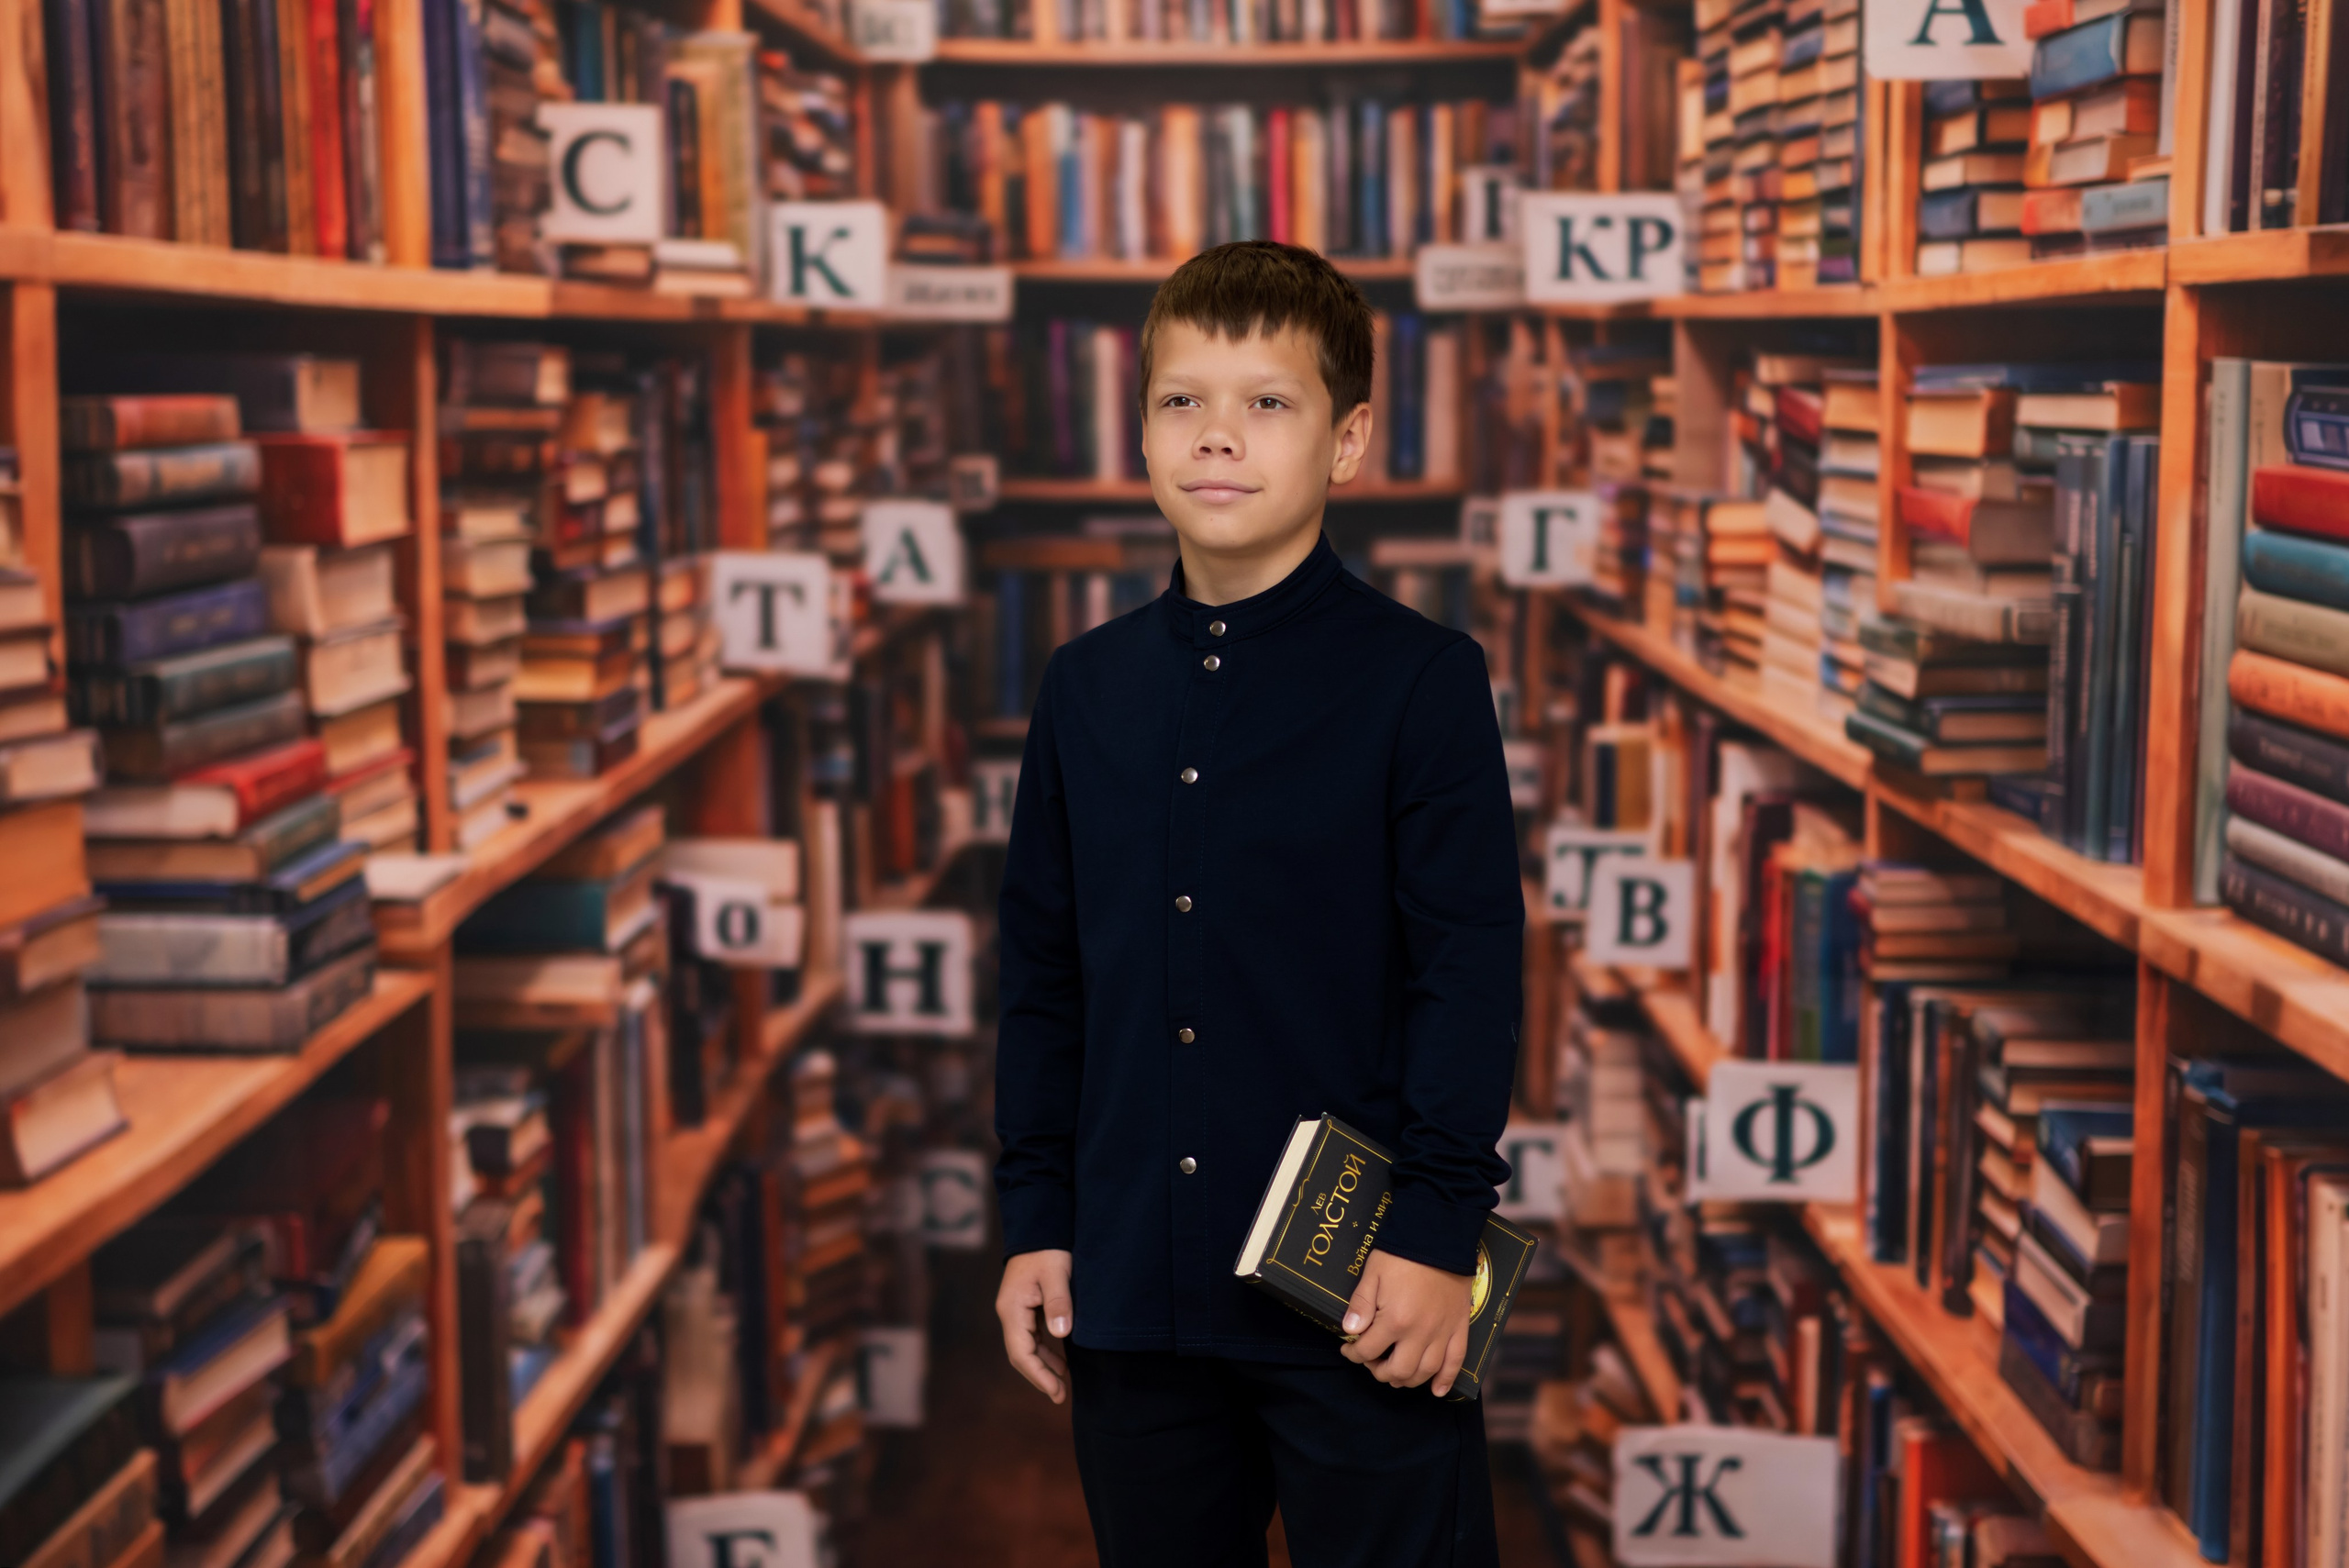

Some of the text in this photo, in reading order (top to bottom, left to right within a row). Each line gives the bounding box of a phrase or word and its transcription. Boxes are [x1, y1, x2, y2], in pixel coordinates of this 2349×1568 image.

[561, 128, 632, 217] С
[786, 225, 856, 298] К
[1553, 214, 1674, 282] КР
[878, 526, 934, 584] А
[1529, 506, 1578, 573] Г
[729, 580, 805, 651] Т
[1616, 876, 1669, 949] В
[858, 940, 949, 1017] Н
[1731, 1081, 1837, 1185] Ф
[1303, 1152, 1366, 1266] ТОЛСТОЙ
[1310, 1192, 1327, 1216] ЛЕВ
[1347, 1191, 1394, 1276] Война и мир
[1630, 1453, 1746, 1540] Ж
